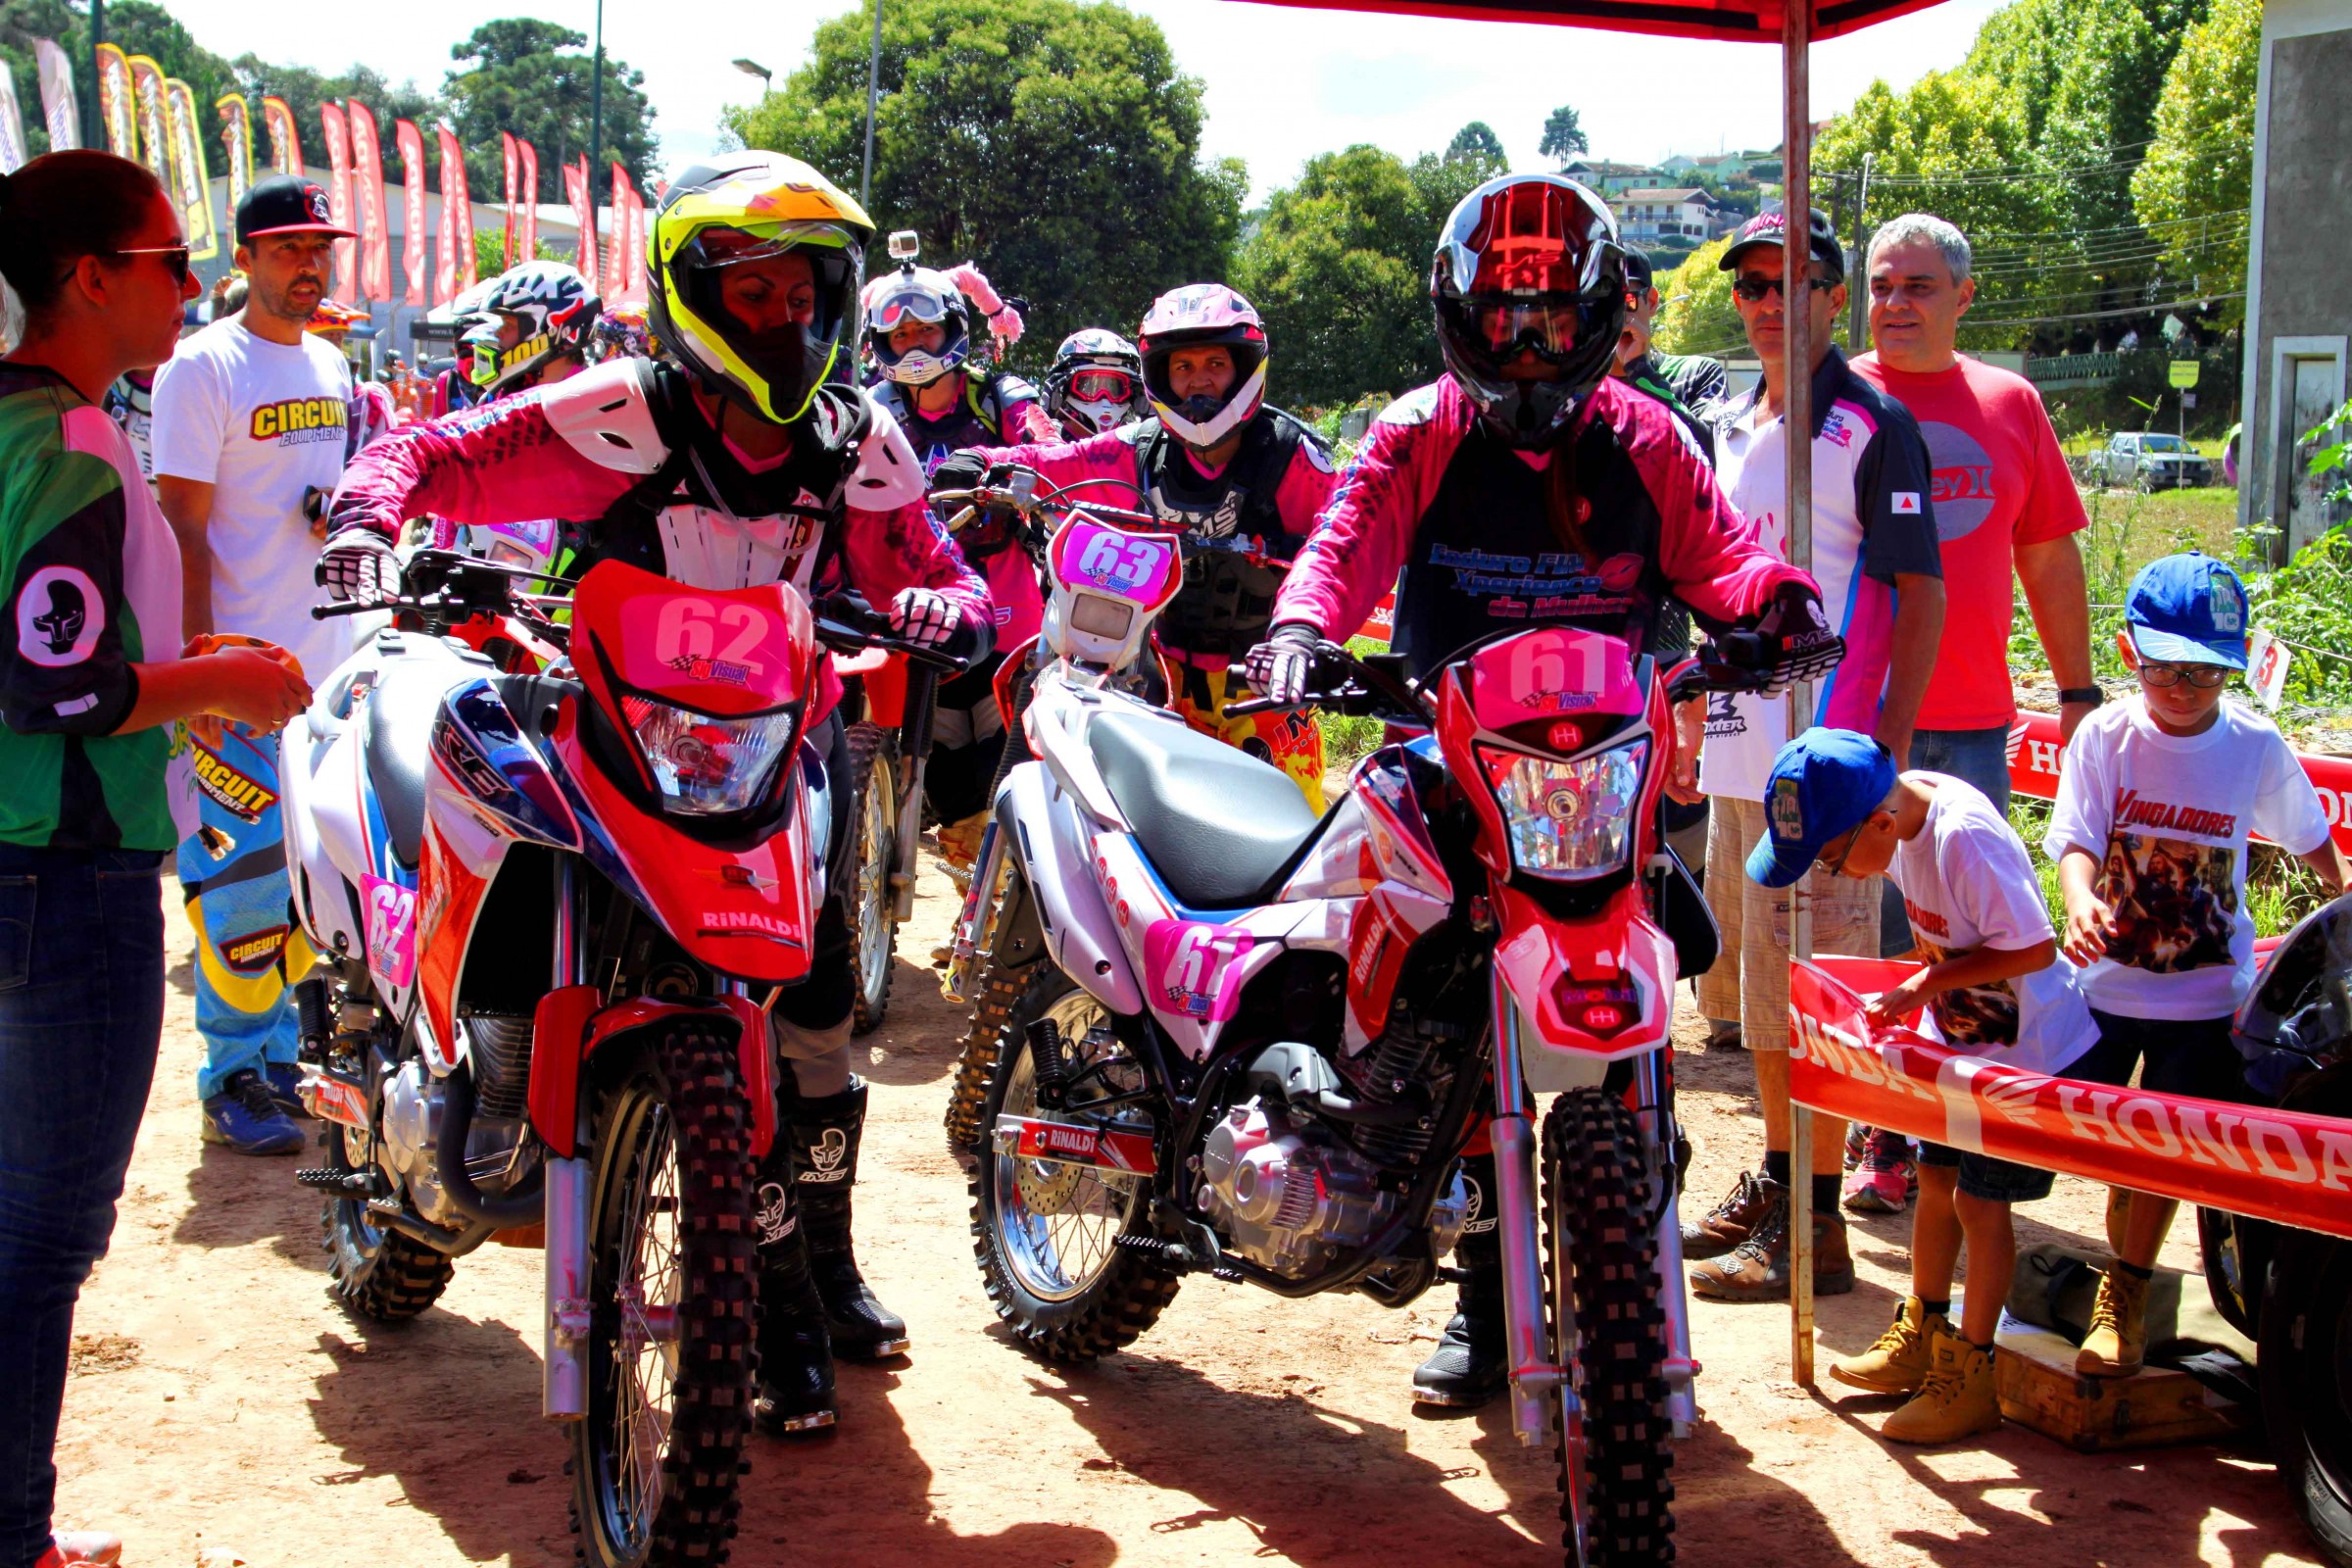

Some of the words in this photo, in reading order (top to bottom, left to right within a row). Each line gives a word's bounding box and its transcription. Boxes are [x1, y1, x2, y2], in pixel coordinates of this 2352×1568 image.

[500, 323, 571, 368] 100%
[1079, 531, 1160, 588] 63
[1428, 542, 1532, 573] Enduro
[1451, 568, 1603, 597] Xperience
[1488, 596, 1528, 618] da
[1531, 594, 1634, 618] Mulher
[656, 597, 769, 676] 62
[1782, 628, 1835, 652] IMS
[1511, 633, 1606, 704] 61
[2256, 645, 2279, 688] 3
[229, 933, 284, 960] CIRCUIT
[369, 884, 415, 966] 62
[1163, 925, 1243, 1002] 61
[1461, 1216, 1498, 1234] MS
